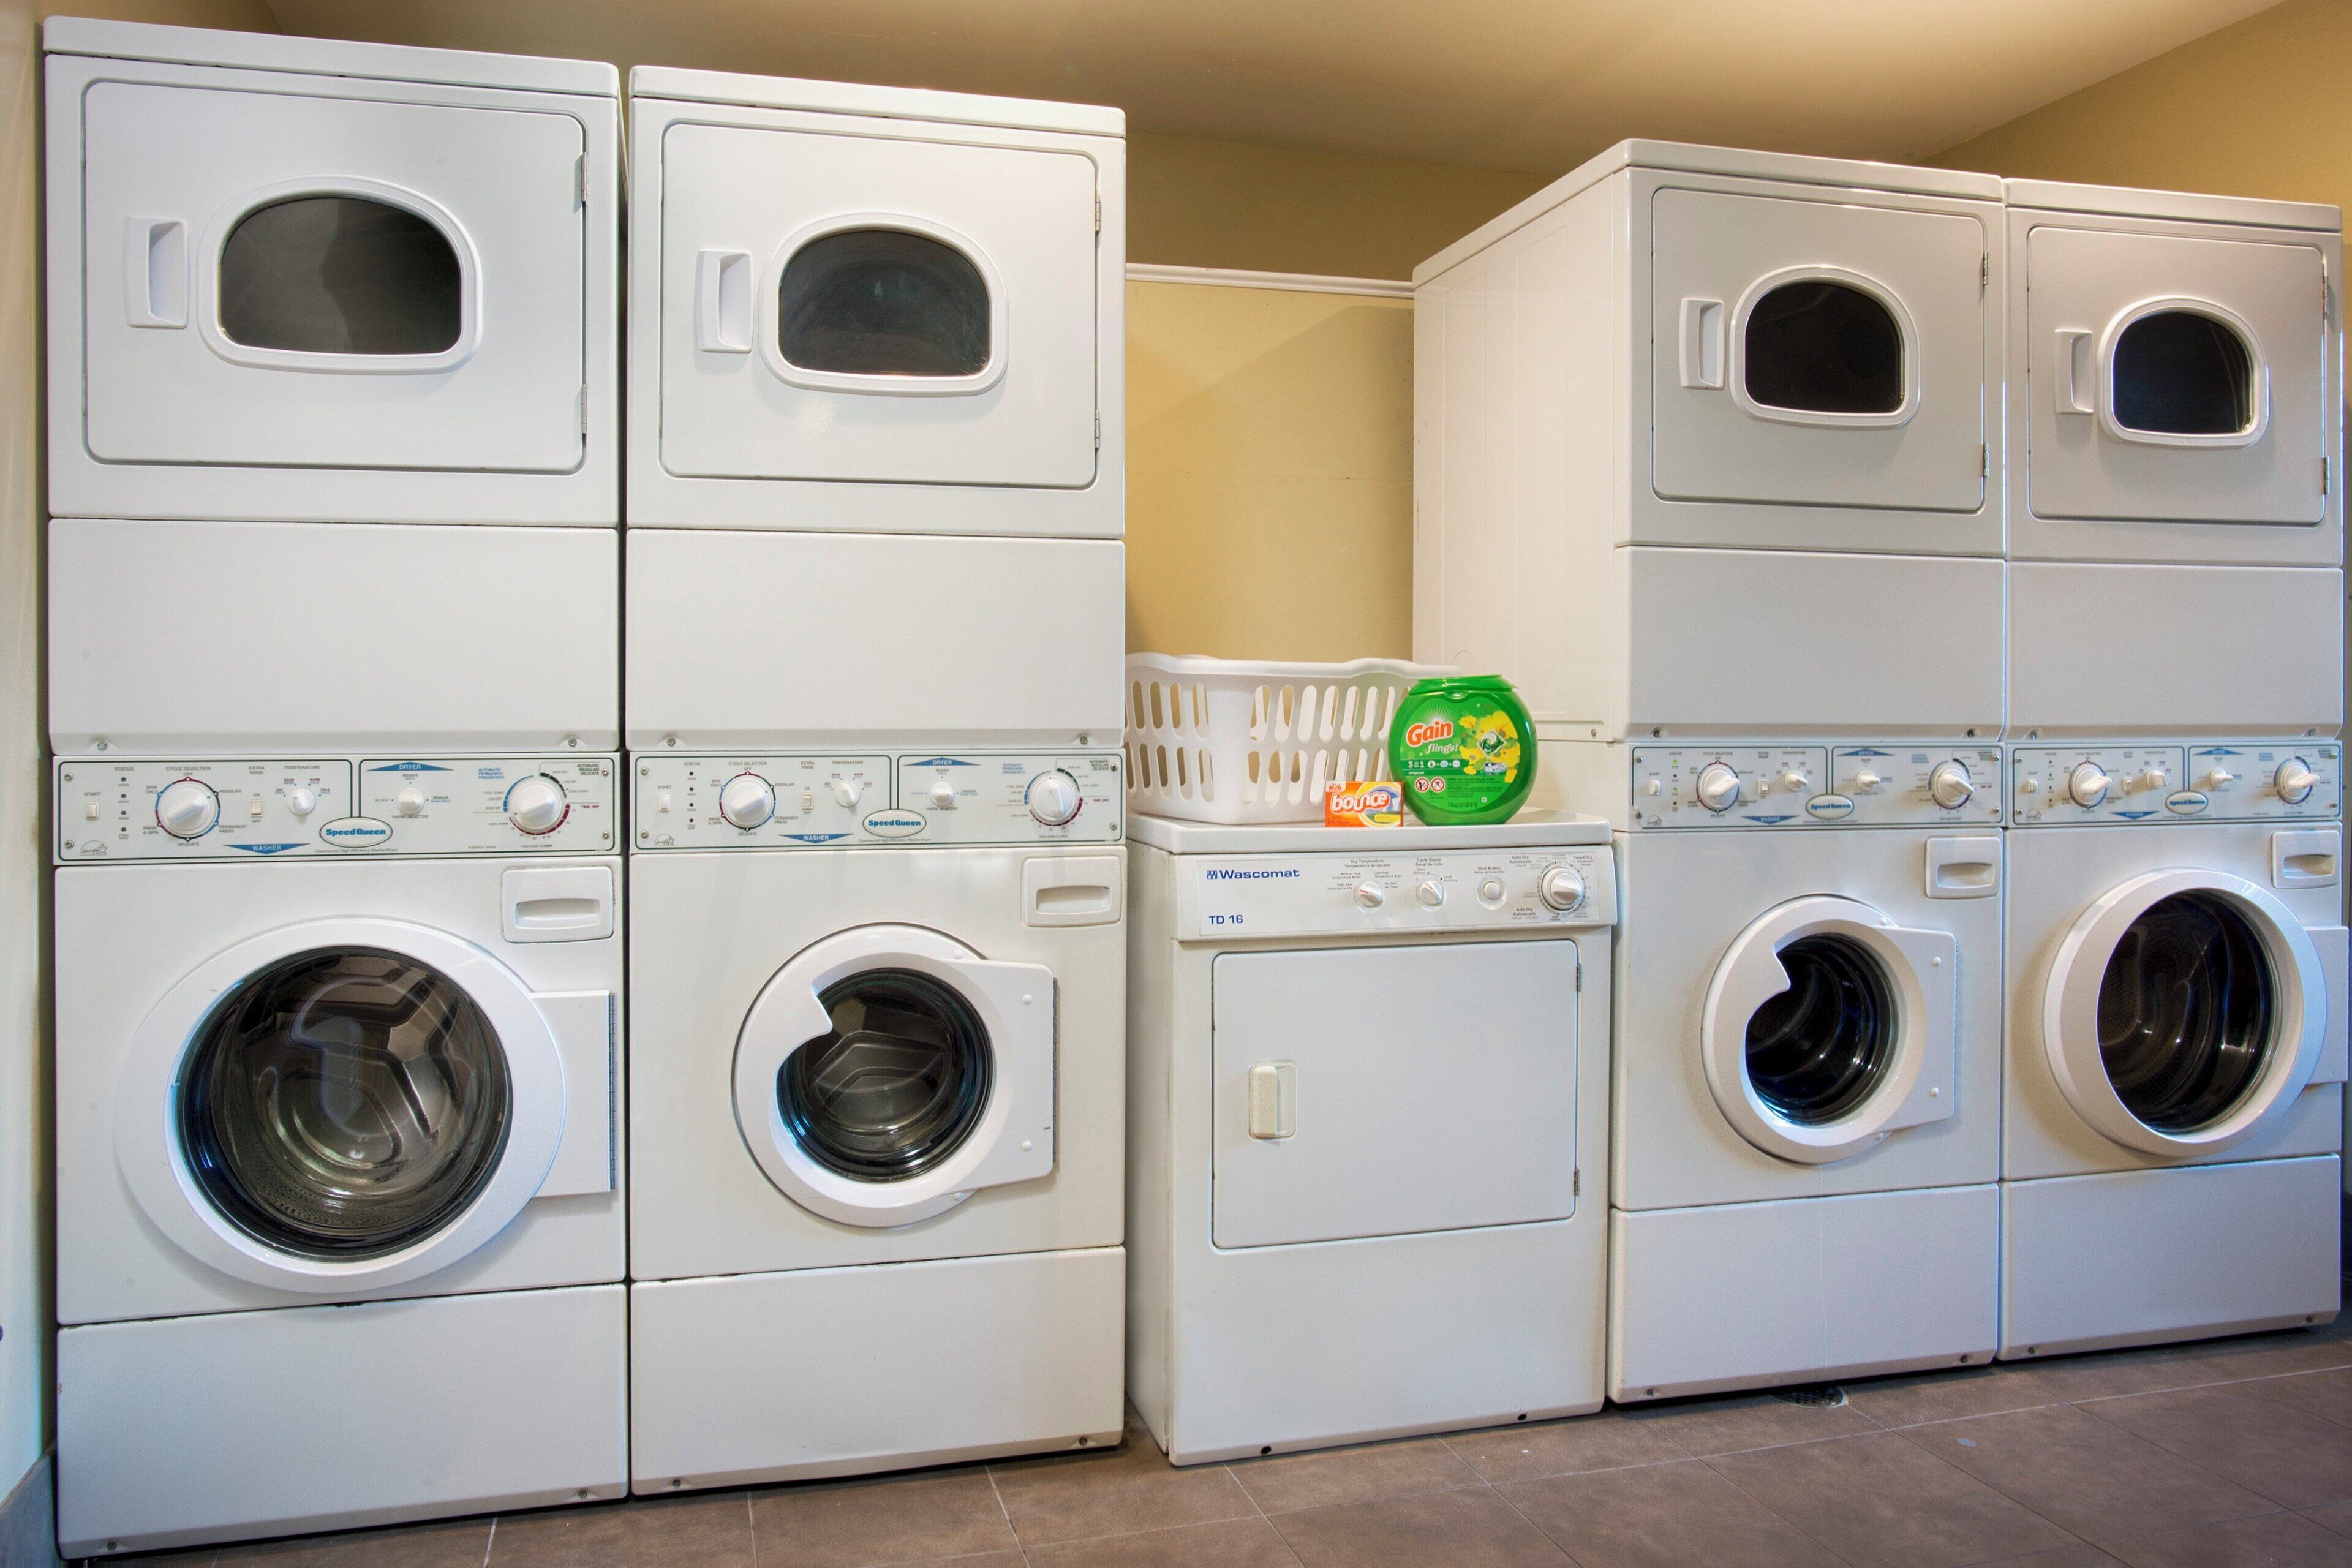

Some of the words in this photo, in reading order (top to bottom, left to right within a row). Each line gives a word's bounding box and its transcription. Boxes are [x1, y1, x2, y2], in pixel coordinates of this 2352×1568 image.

[1407, 721, 1452, 746] Gain
[1426, 744, 1458, 754] flings!
[1331, 792, 1389, 812] bounce
[1219, 869, 1300, 879] Wascomat
[1209, 916, 1224, 924] TD
[1229, 915, 1243, 924] 16
